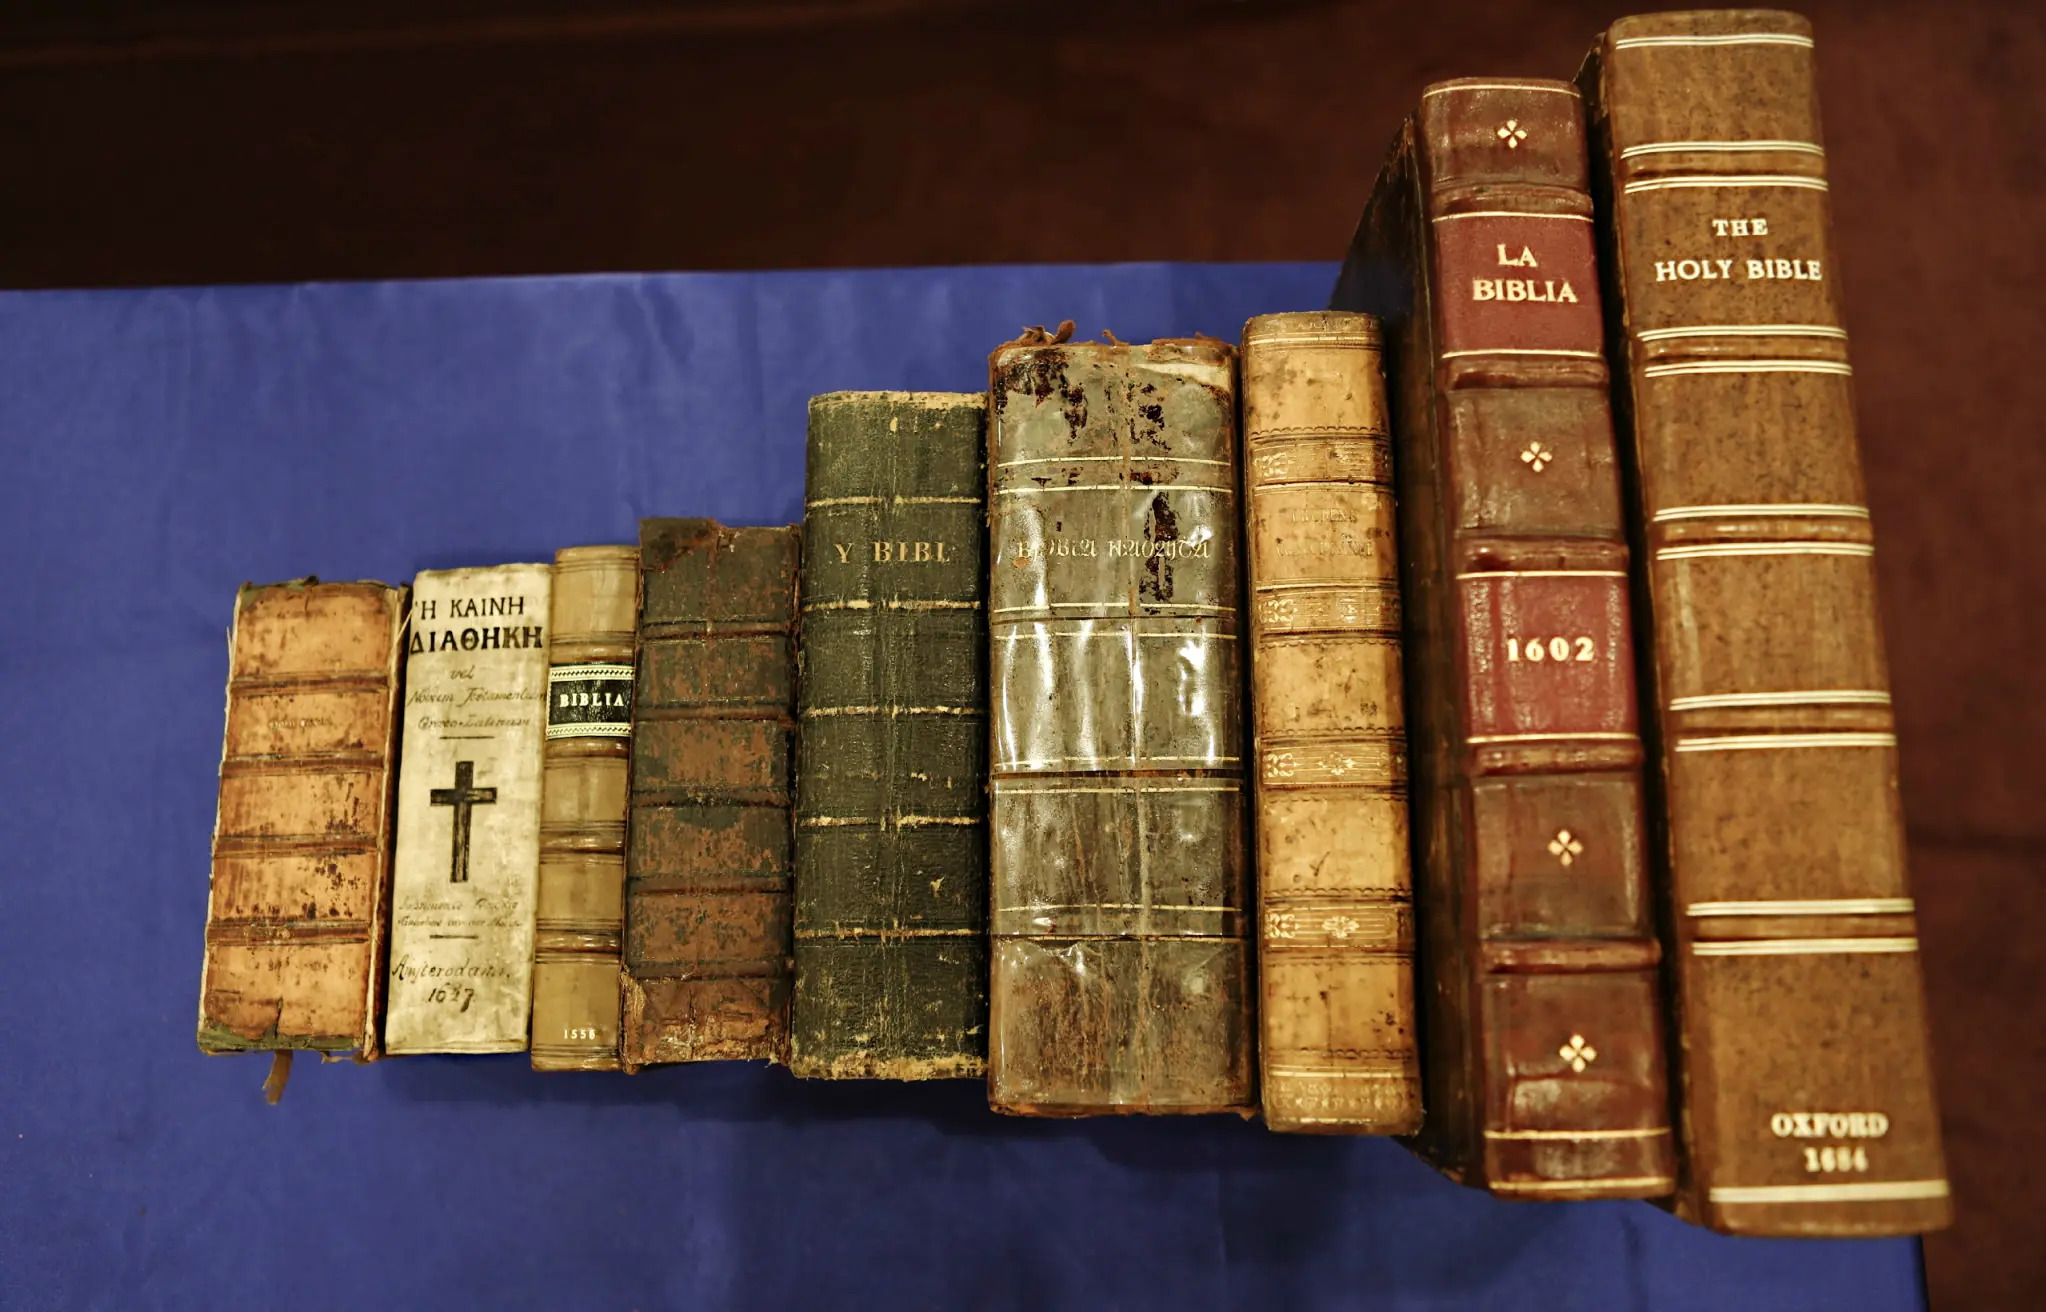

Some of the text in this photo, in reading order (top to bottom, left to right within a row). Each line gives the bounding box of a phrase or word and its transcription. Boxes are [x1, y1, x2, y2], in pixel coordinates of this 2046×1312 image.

[1712, 218, 1769, 237] THE
[1497, 243, 1538, 268] LA
[1655, 258, 1823, 282] HOLY BIBLE
[1472, 279, 1579, 303] BIBLIA
[833, 542, 855, 564] Y
[449, 596, 525, 618] ΚΑΙΝΗ
[409, 626, 543, 655] ΔΙΑΘΗΚΗ
[1507, 636, 1596, 662] 1602
[559, 692, 625, 708] BIBLIA
[1770, 1112, 1889, 1138] OXFORD
